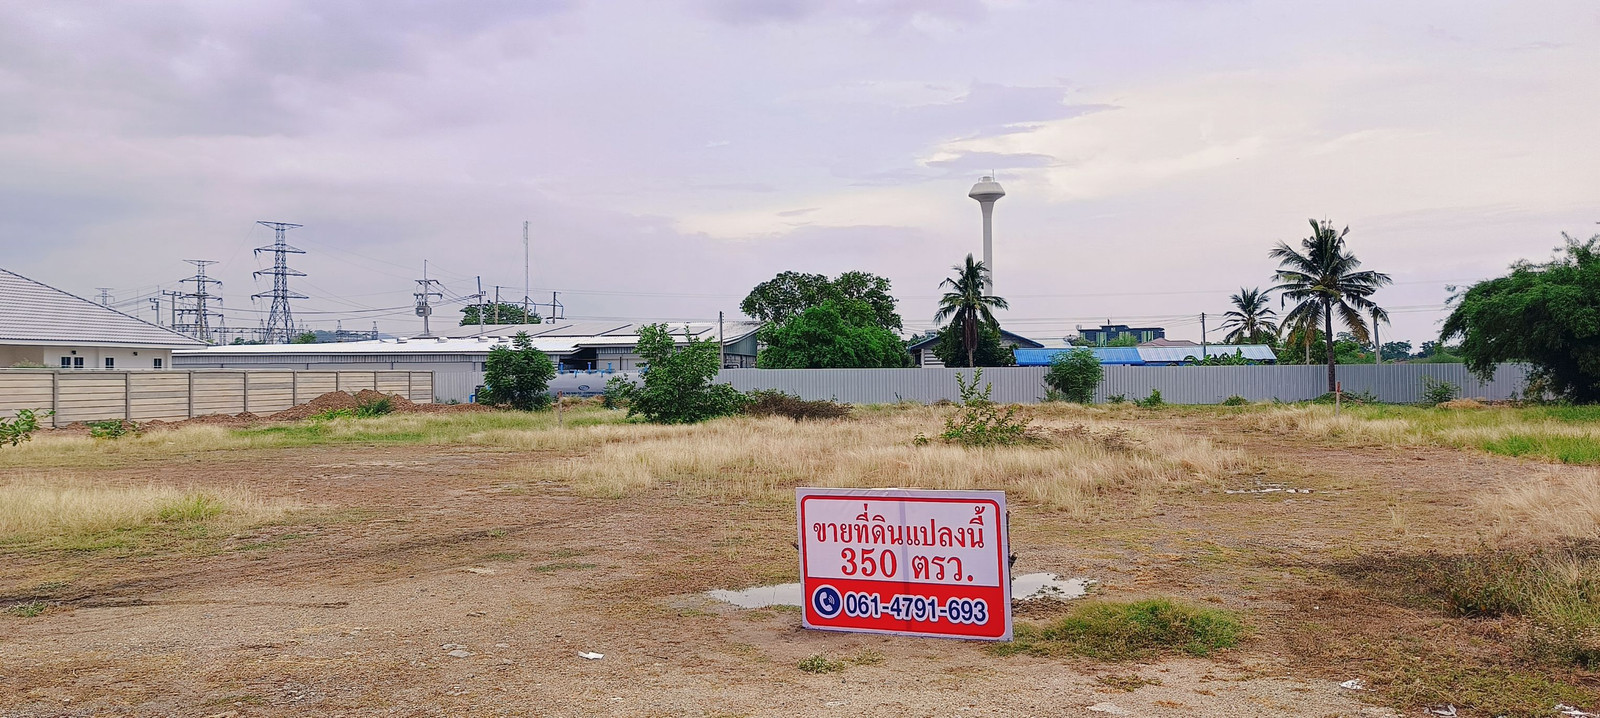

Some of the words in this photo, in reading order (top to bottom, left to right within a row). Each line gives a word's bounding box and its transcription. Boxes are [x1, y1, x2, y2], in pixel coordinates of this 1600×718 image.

[813, 503, 985, 549] ขายที่ดินแปลงนี้
[841, 547, 898, 578] 350
[911, 555, 974, 582] ตรว.
[845, 593, 987, 623] 061-4791-693
